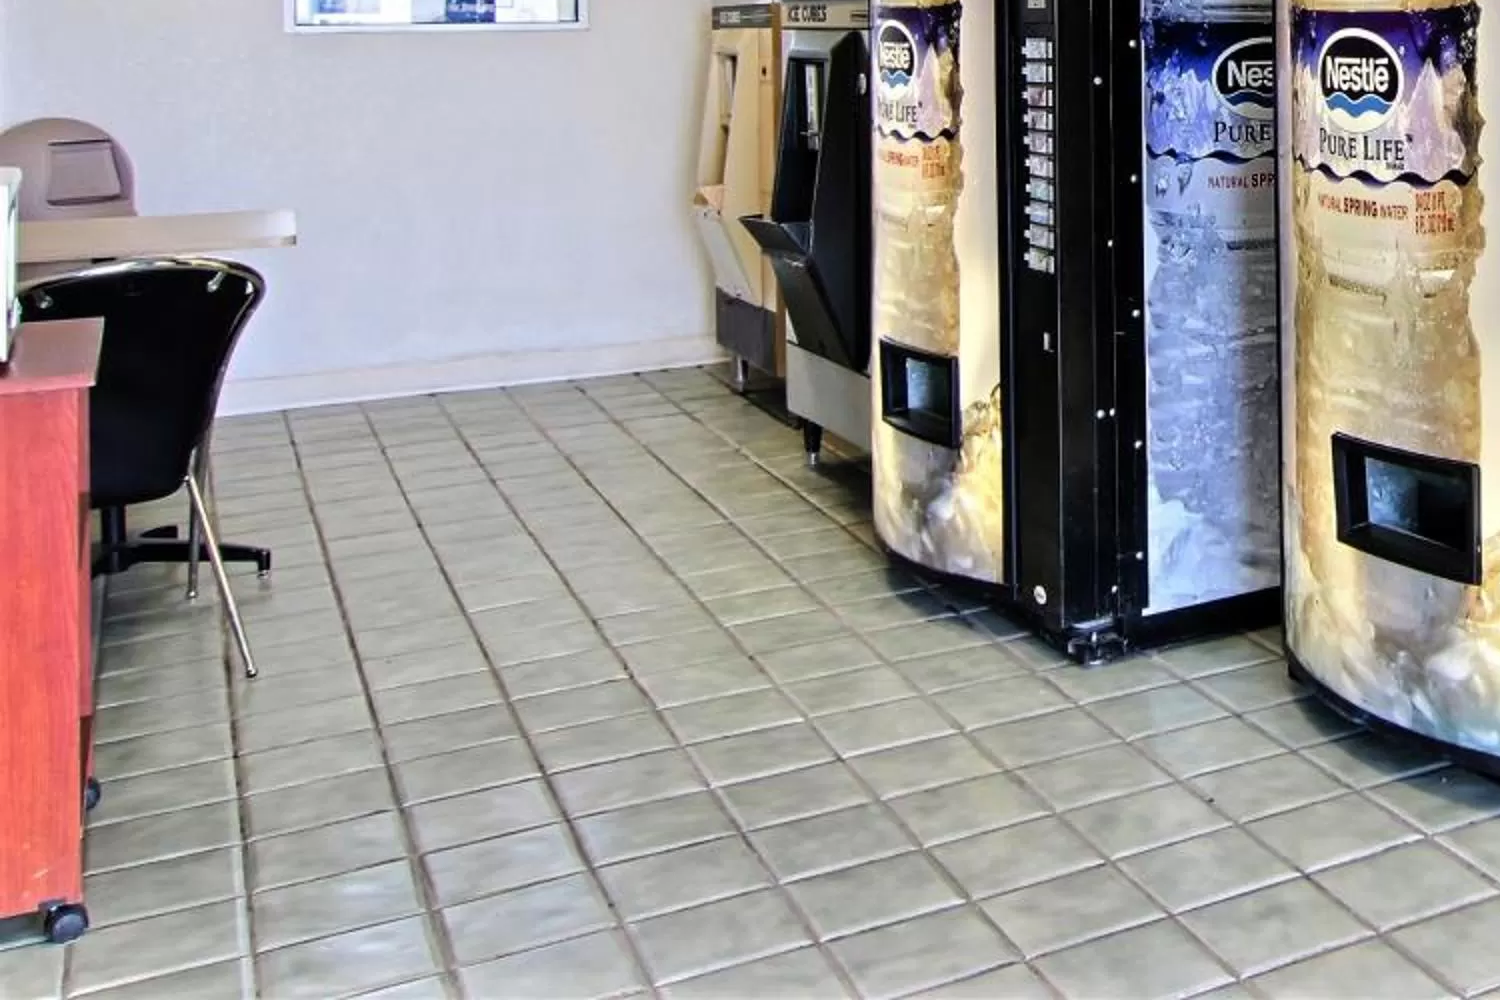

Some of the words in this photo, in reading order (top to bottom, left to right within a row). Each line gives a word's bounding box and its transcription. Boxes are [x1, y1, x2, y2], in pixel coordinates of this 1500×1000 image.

[1325, 56, 1389, 92] Nestlé
[896, 101, 917, 123] LIFE
[1214, 120, 1271, 144] PURE
[1319, 127, 1357, 160] PURE
[1363, 135, 1405, 161] LIFE
[1207, 175, 1249, 189] NATURAL
[1343, 197, 1377, 217] SPRING
